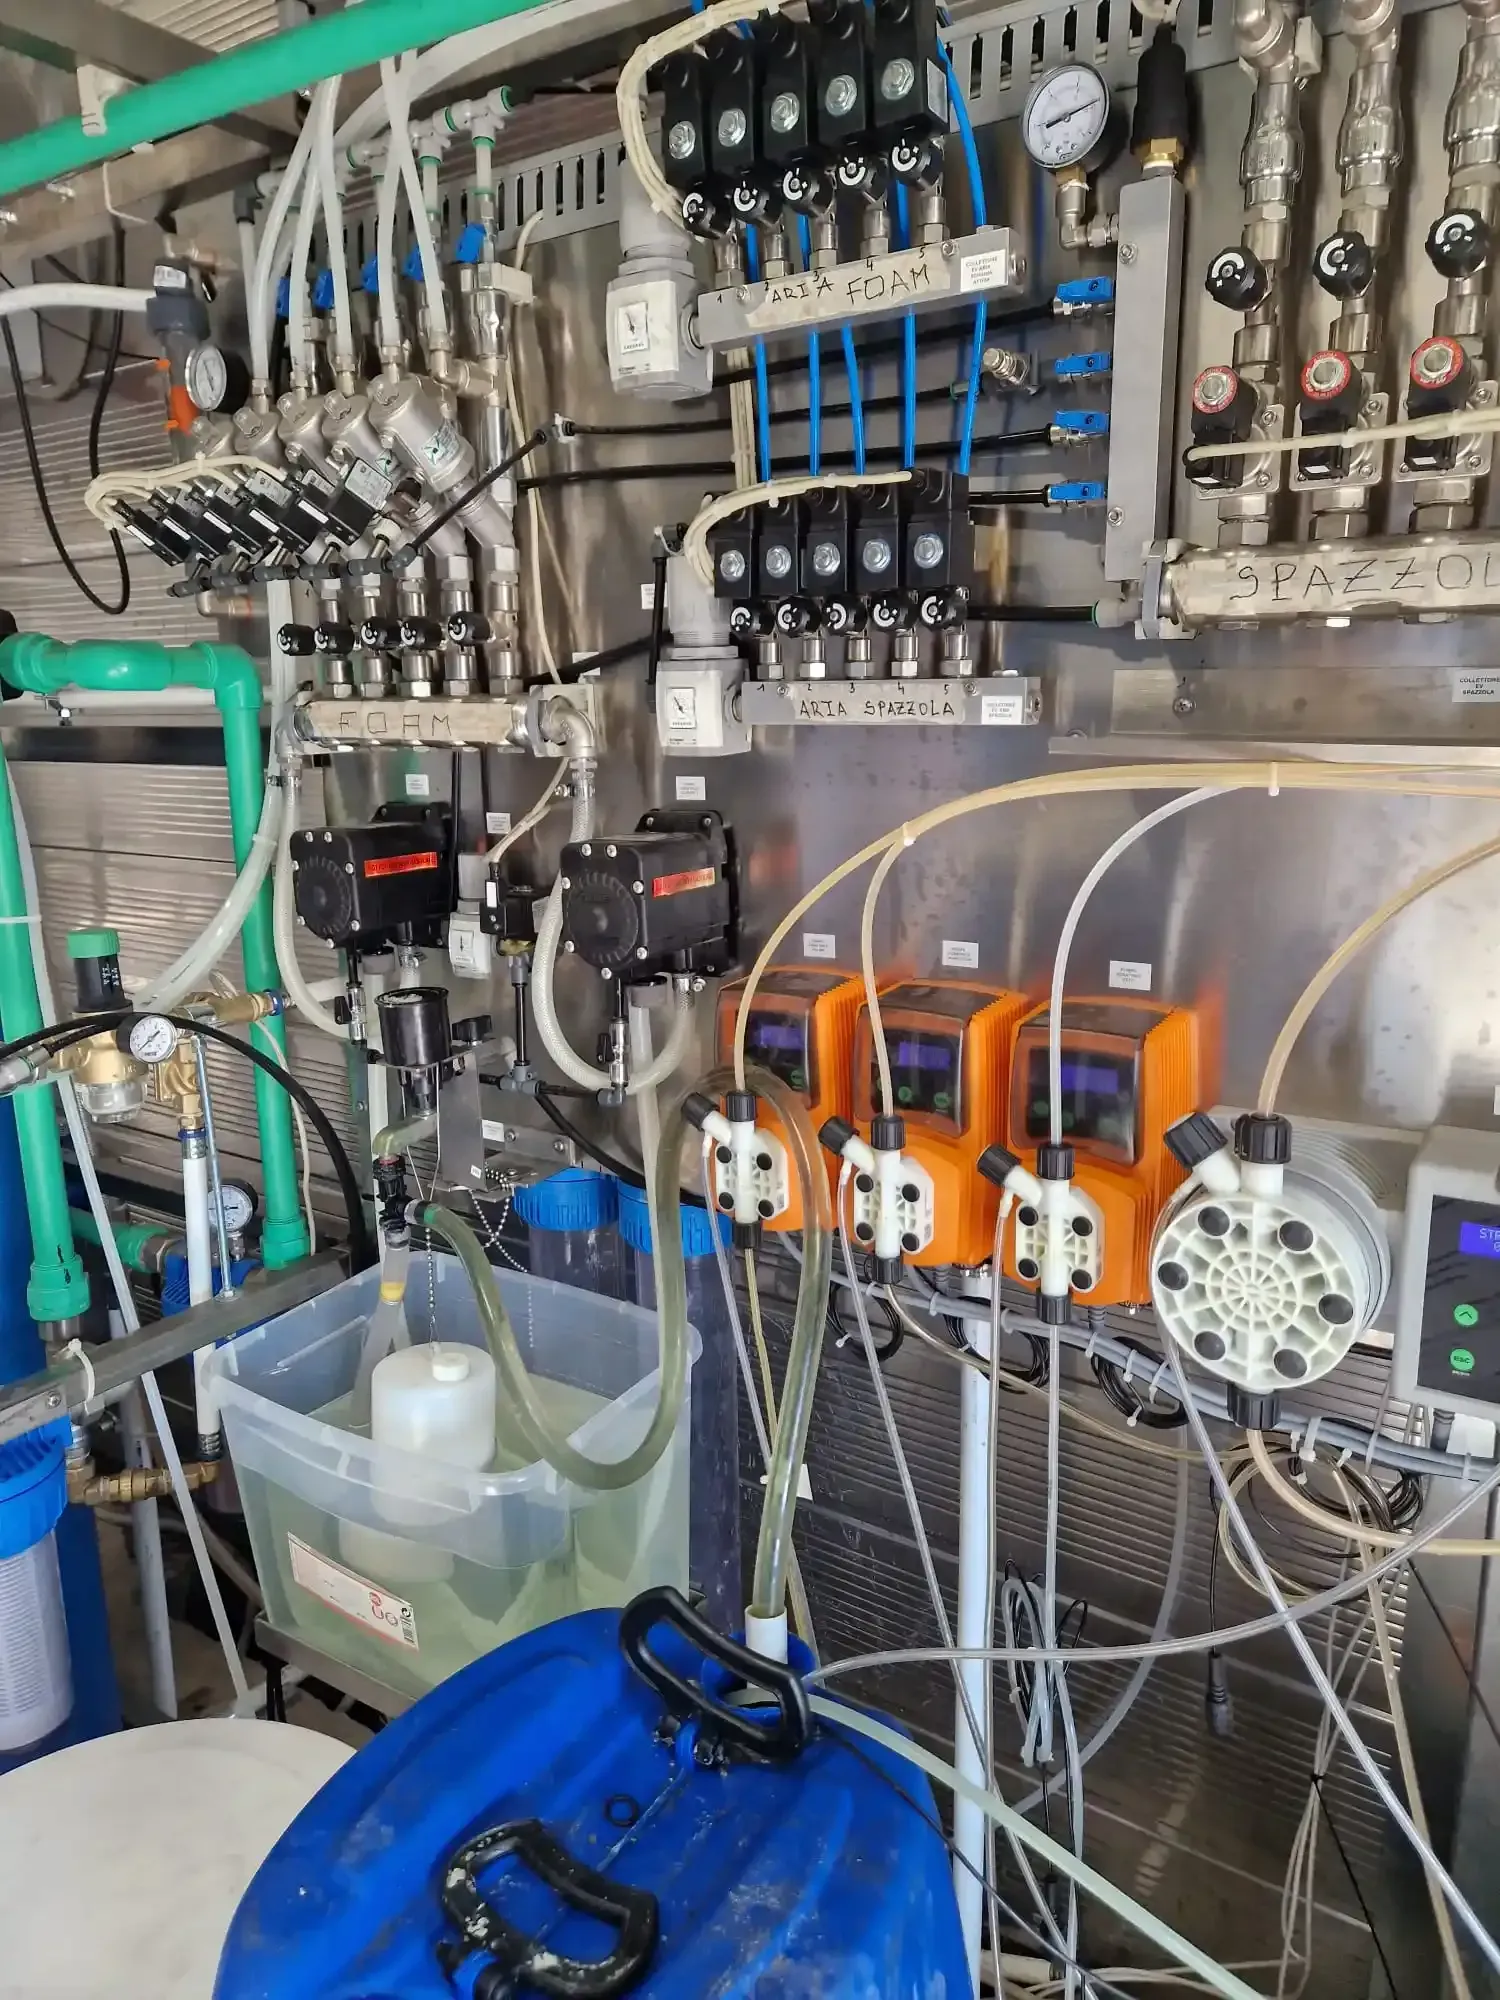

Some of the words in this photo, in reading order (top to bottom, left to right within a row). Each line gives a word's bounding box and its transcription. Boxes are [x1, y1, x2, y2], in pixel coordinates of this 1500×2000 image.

[764, 281, 770, 292] 2
[813, 270, 820, 283] 3
[866, 259, 874, 272] 4
[919, 246, 926, 259] 5
[772, 275, 834, 304] ARIA
[846, 263, 931, 305] FOAM
[807, 683, 813, 692] 2
[849, 682, 856, 694] 3
[897, 681, 905, 695] 4
[943, 683, 950, 695] 5
[799, 700, 848, 718] ARIA
[863, 699, 956, 717] SPAZZOLA
[338, 711, 452, 737] FOAM
